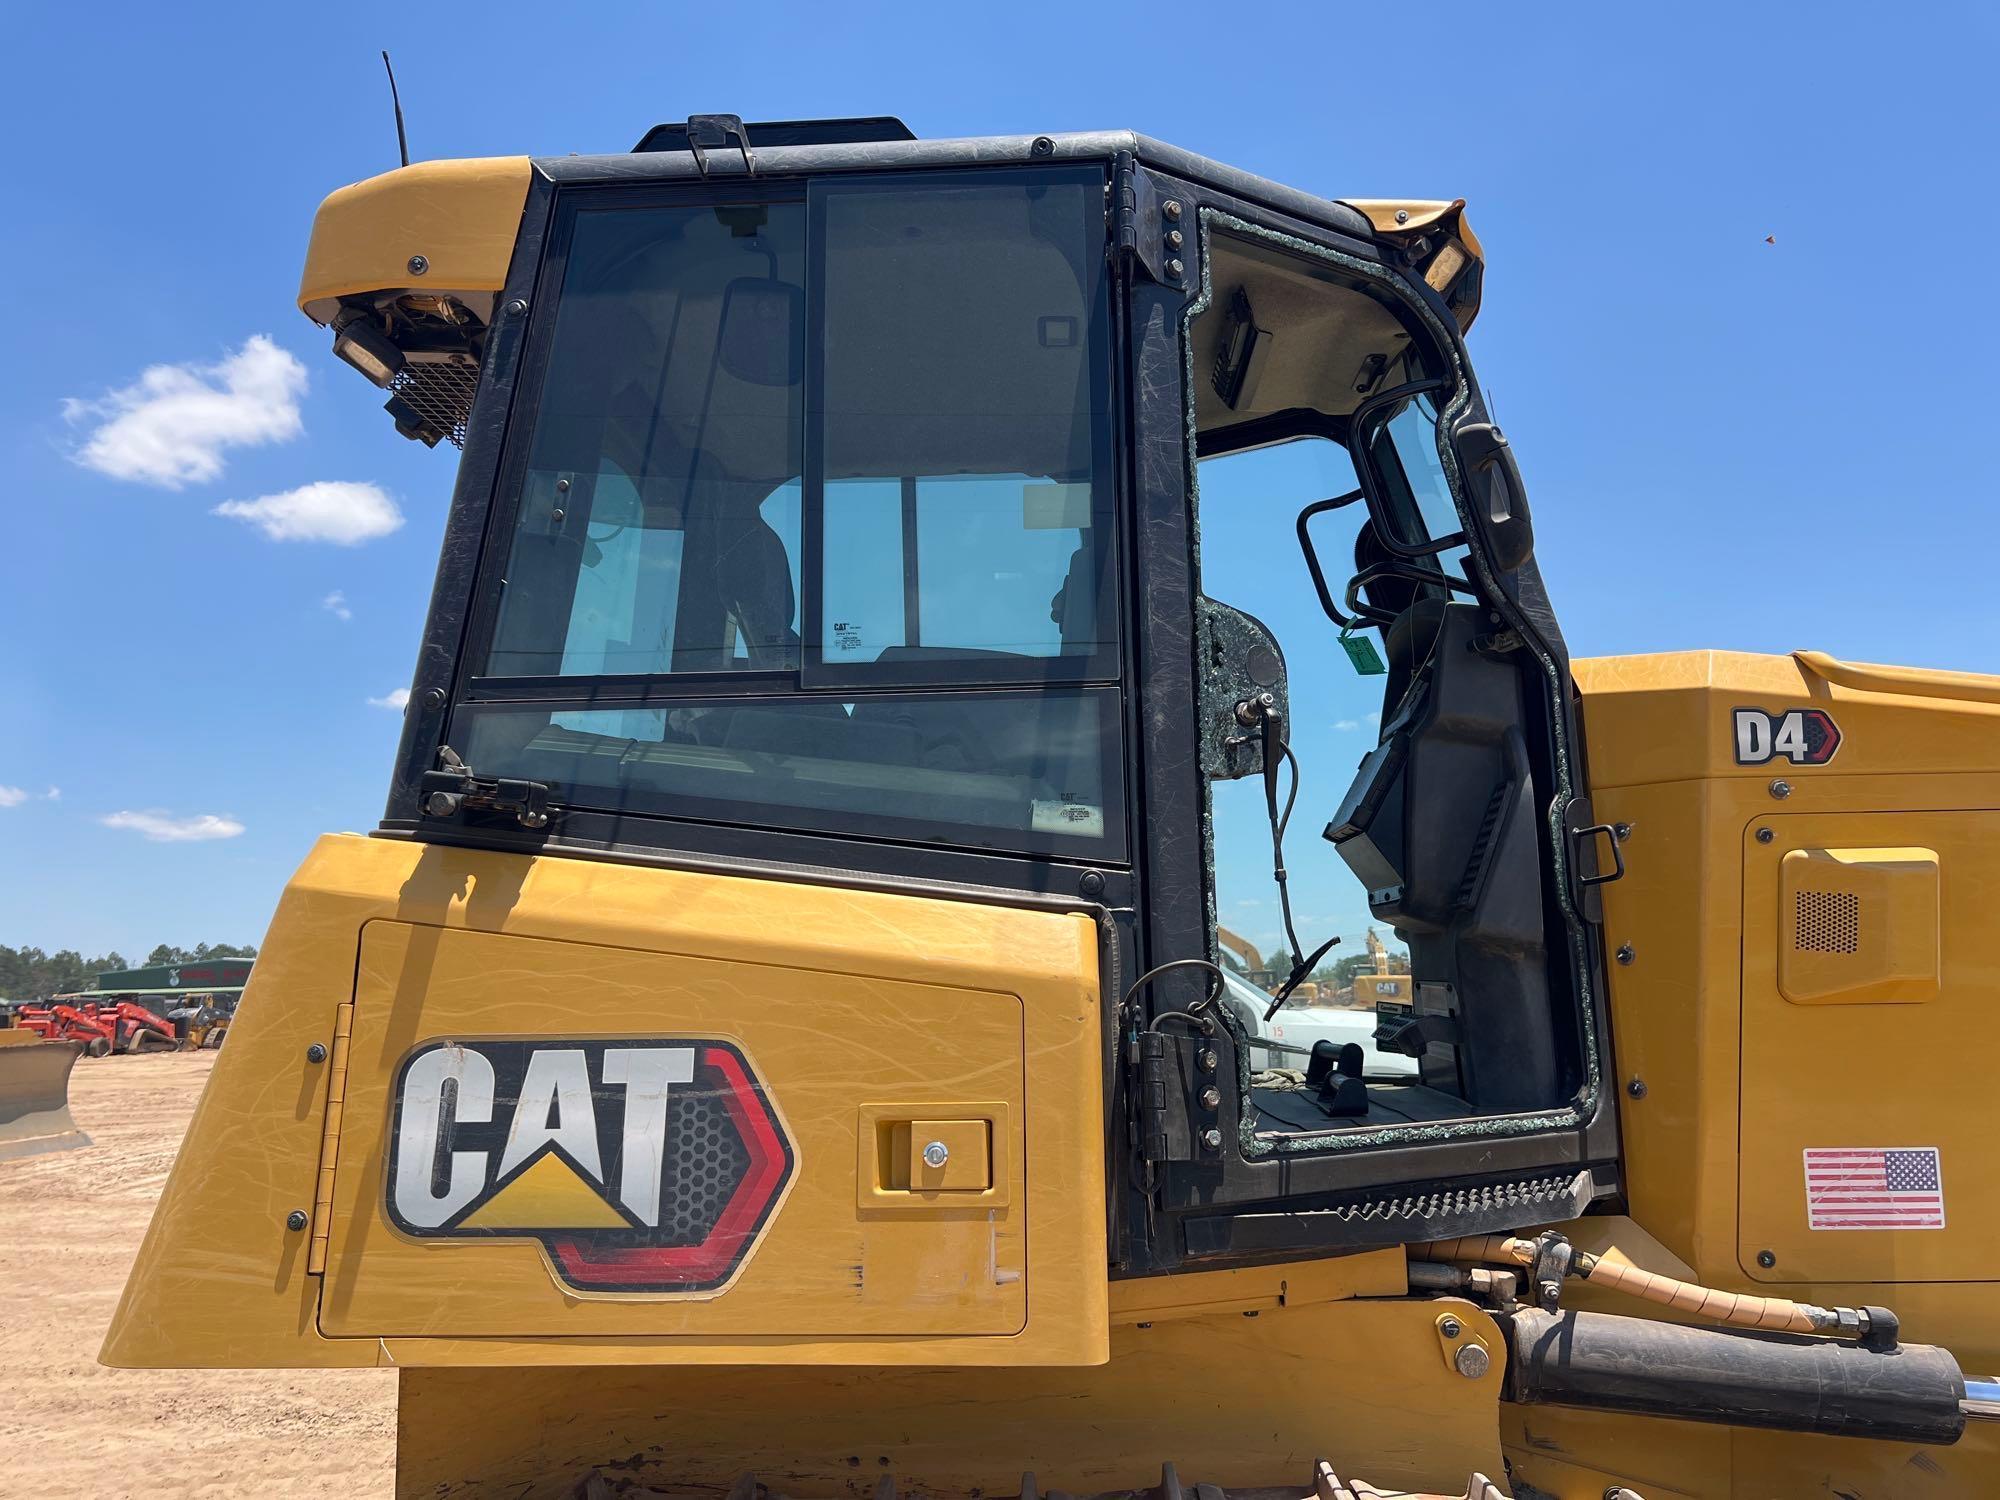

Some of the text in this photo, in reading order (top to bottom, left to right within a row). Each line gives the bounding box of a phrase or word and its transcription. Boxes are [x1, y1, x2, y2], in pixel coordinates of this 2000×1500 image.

[834, 623, 848, 631] CAT
[1736, 711, 1808, 761] D4
[1376, 982, 1396, 994] CAT
[395, 1047, 695, 1228] CAT
